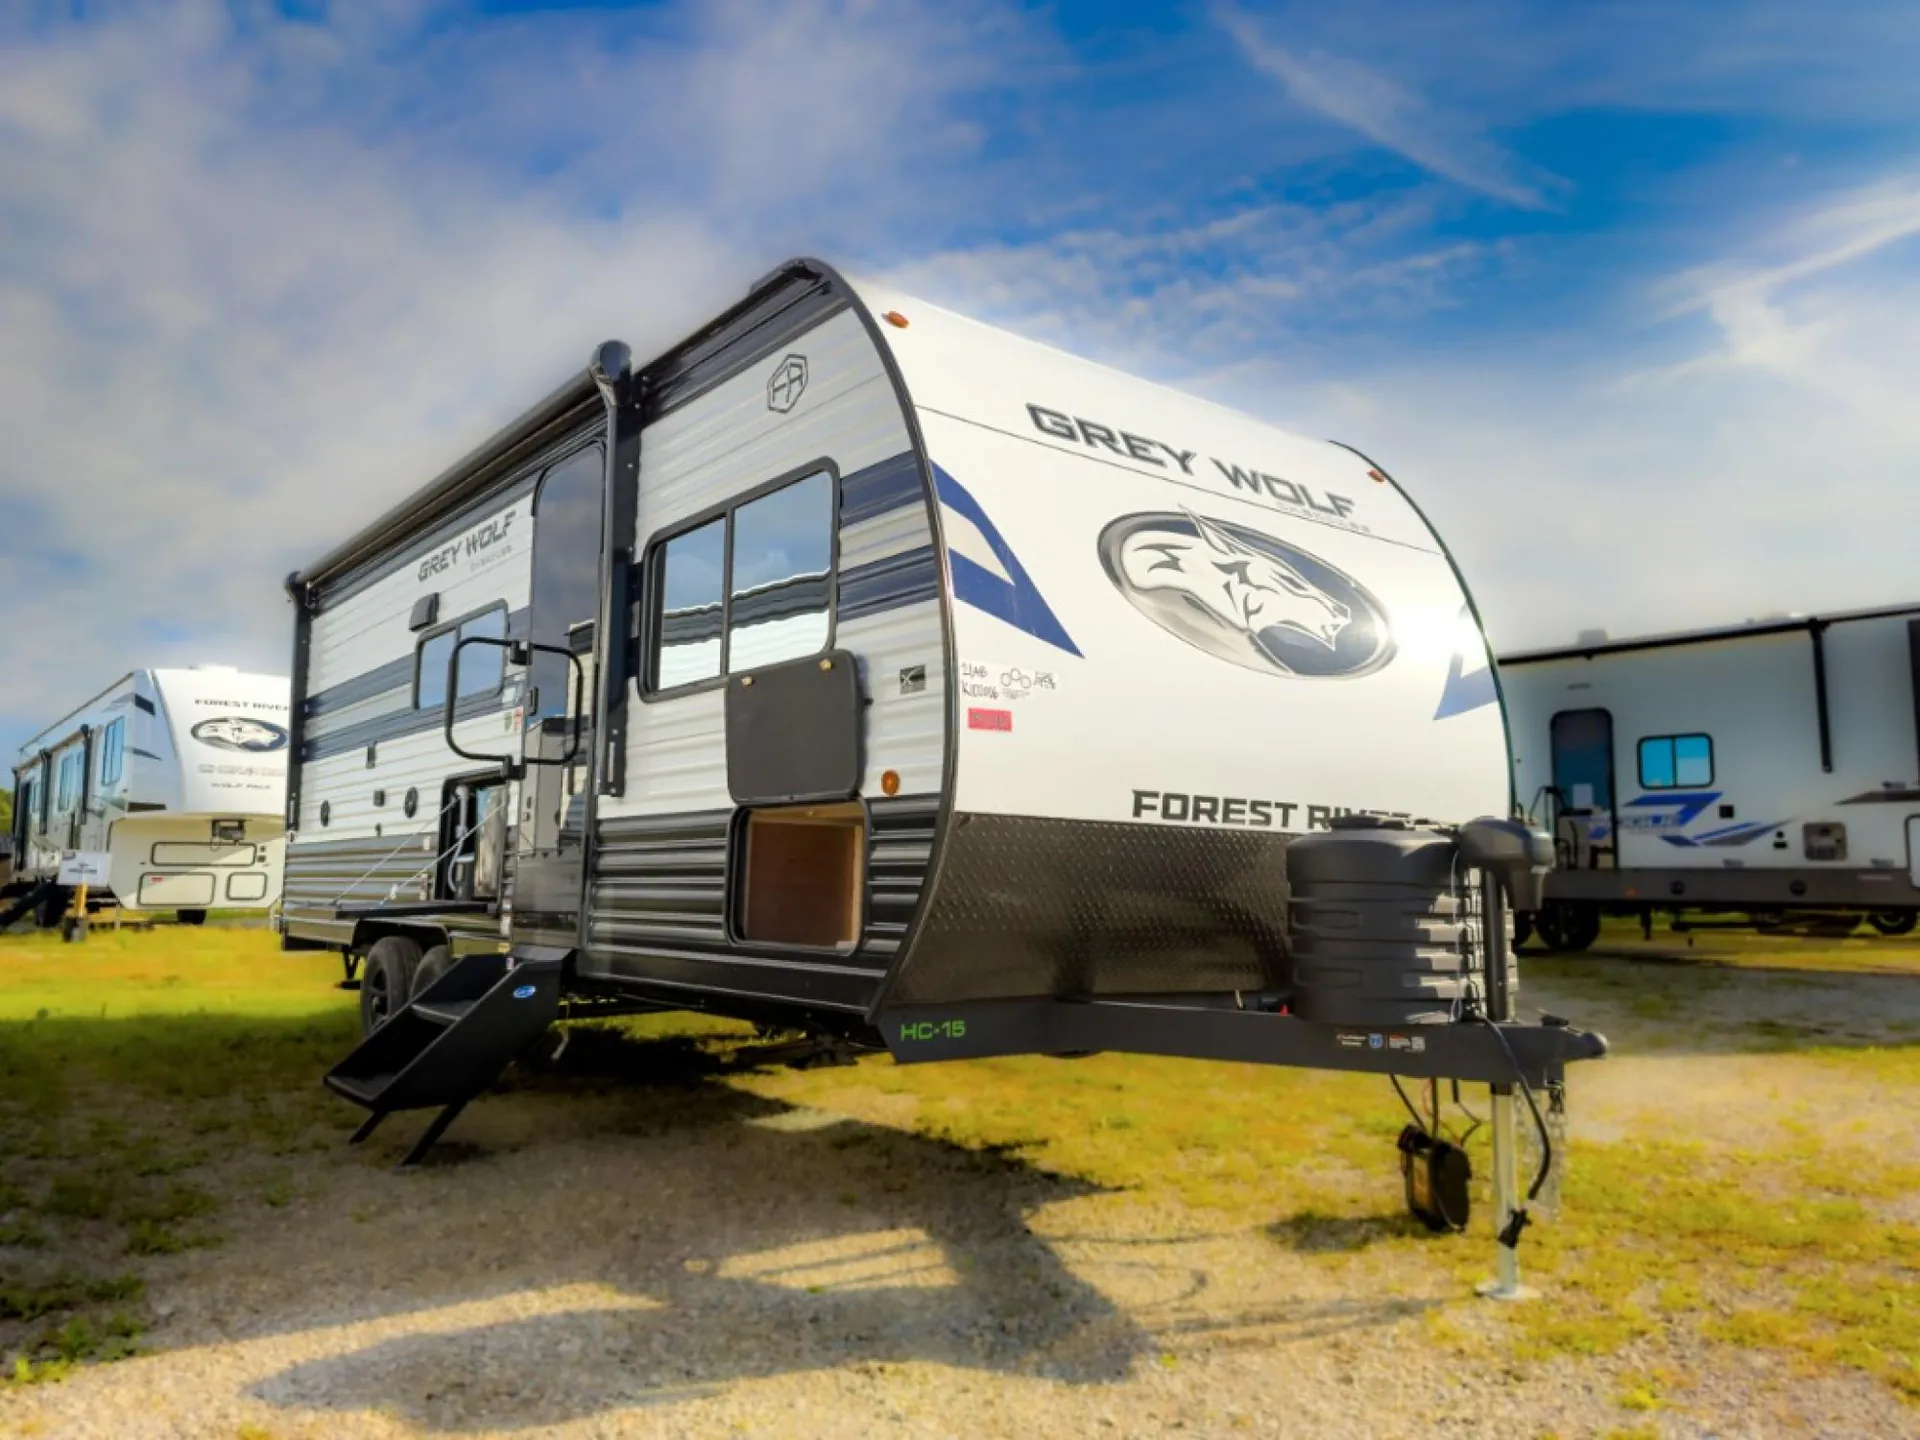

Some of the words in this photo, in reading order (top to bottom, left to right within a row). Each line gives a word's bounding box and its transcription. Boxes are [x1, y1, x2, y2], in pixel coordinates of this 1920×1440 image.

[1025, 402, 1197, 476] GREY
[1208, 456, 1355, 518] WOLF
[418, 540, 462, 582] GREY
[466, 509, 516, 557] WOLF
[1132, 789, 1298, 829] FOREST
